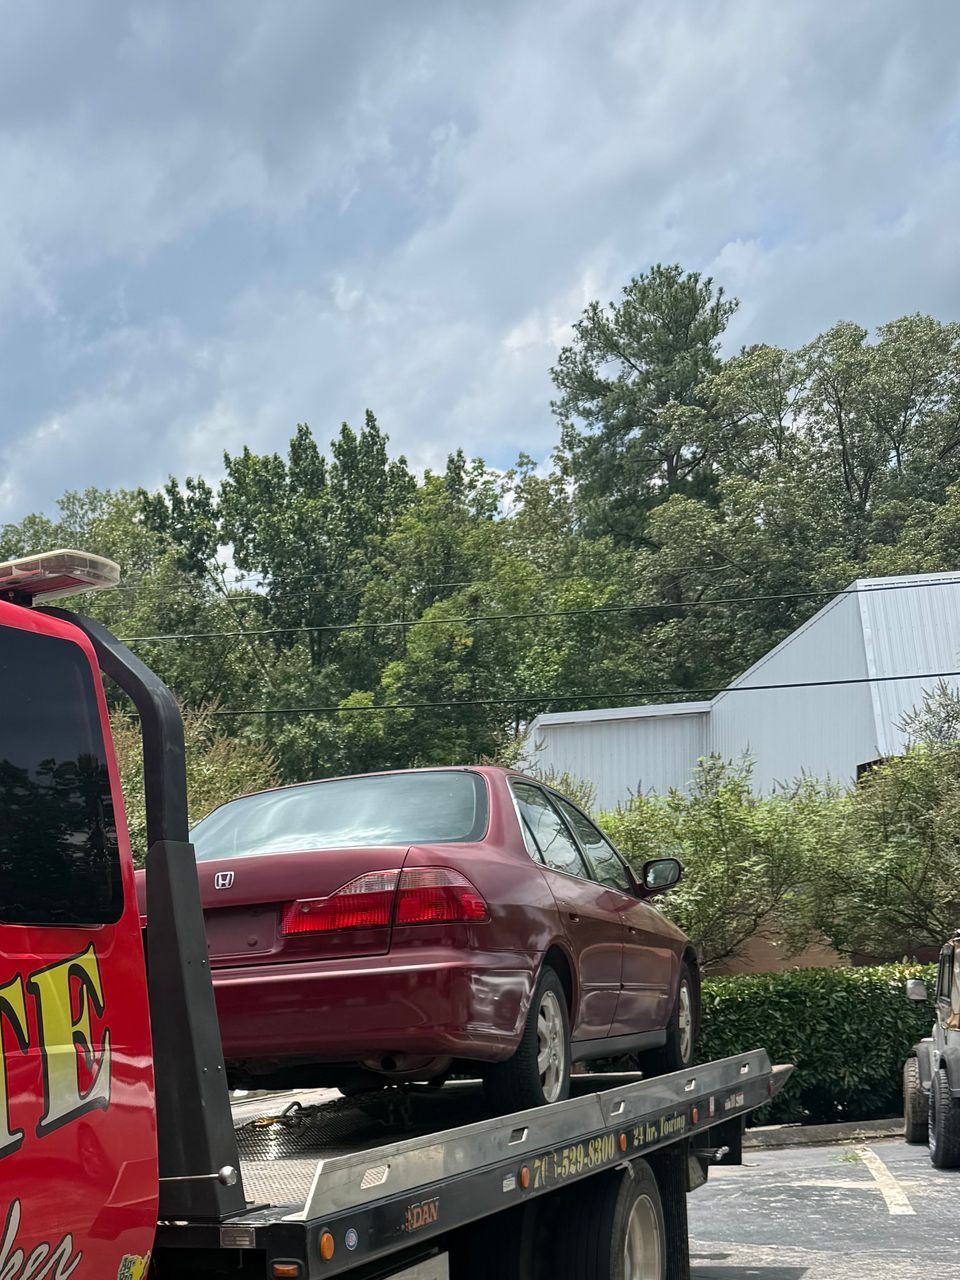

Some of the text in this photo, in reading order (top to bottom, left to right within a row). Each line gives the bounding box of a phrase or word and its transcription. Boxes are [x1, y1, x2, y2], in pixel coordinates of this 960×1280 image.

[633, 1126, 644, 1146] 24
[660, 1112, 686, 1137] Towing
[532, 1133, 615, 1189] 70-529-8300
